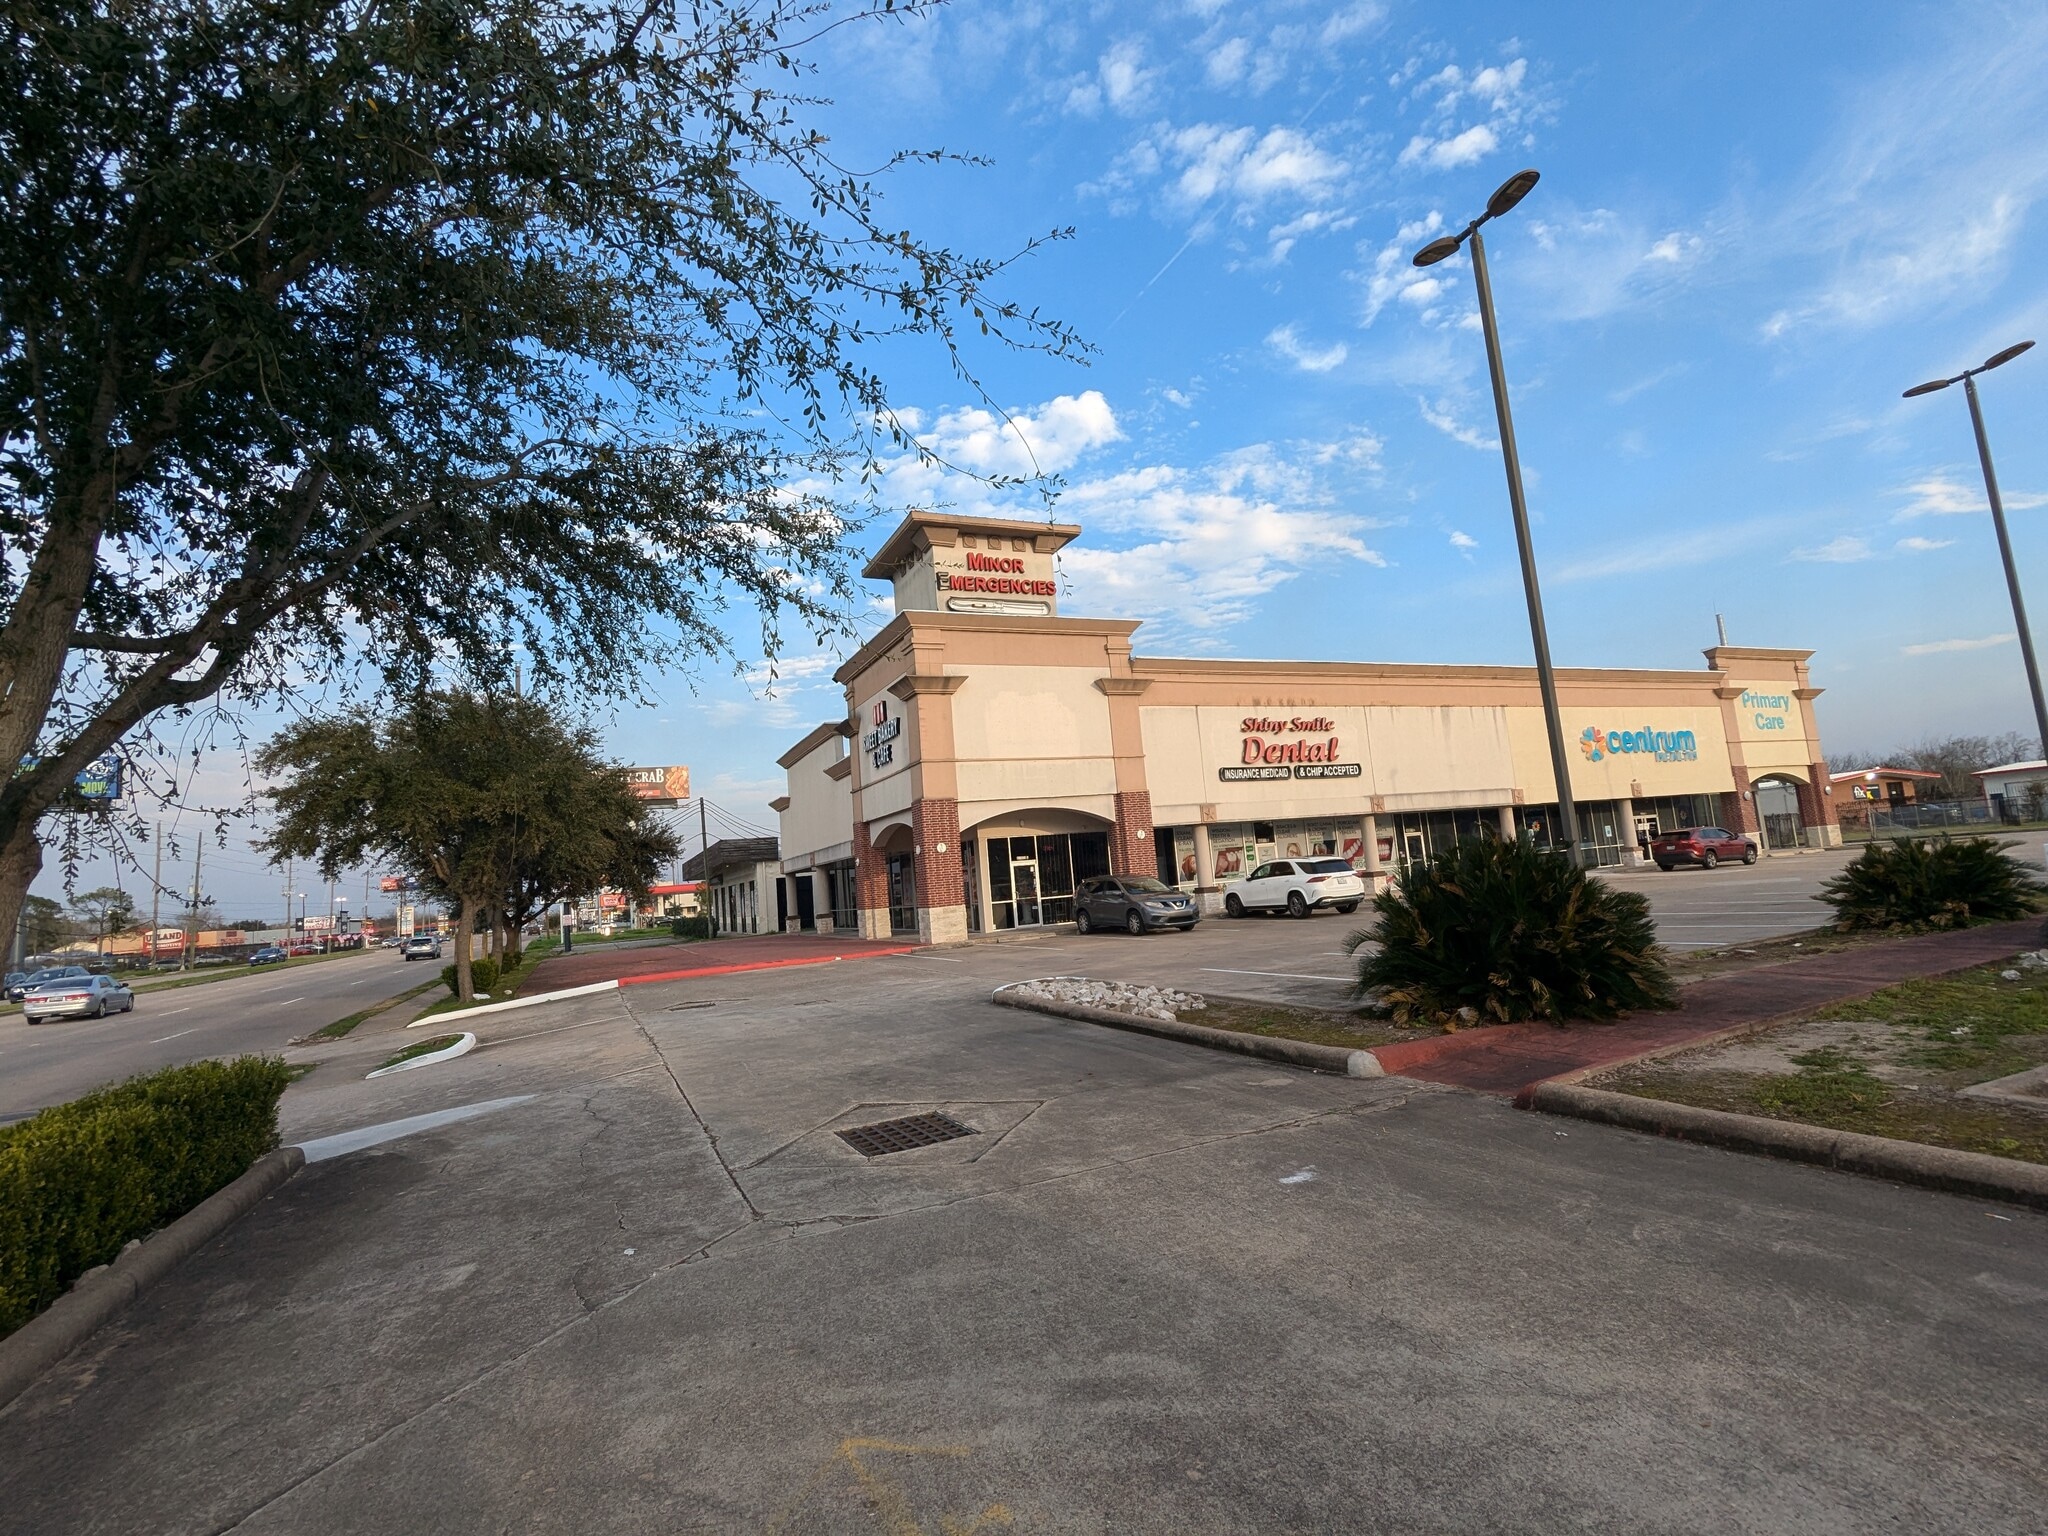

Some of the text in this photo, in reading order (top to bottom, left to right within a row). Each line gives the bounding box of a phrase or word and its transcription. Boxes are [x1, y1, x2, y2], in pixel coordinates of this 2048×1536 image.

[966, 552, 1025, 574] MINOR
[936, 571, 1057, 597] EMERGENCIES
[1742, 691, 1790, 712] Primary
[1241, 717, 1335, 735] Shiny Smile
[1755, 712, 1785, 730] Care
[1605, 725, 1697, 754] centrum
[1242, 736, 1340, 765] Dental
[636, 768, 665, 783] CRAB
[1224, 765, 1360, 780] INSURANCE MEDICAID & CHIP ACCEPTED
[81, 781, 109, 795] MOV
[146, 931, 182, 943] ULAND
